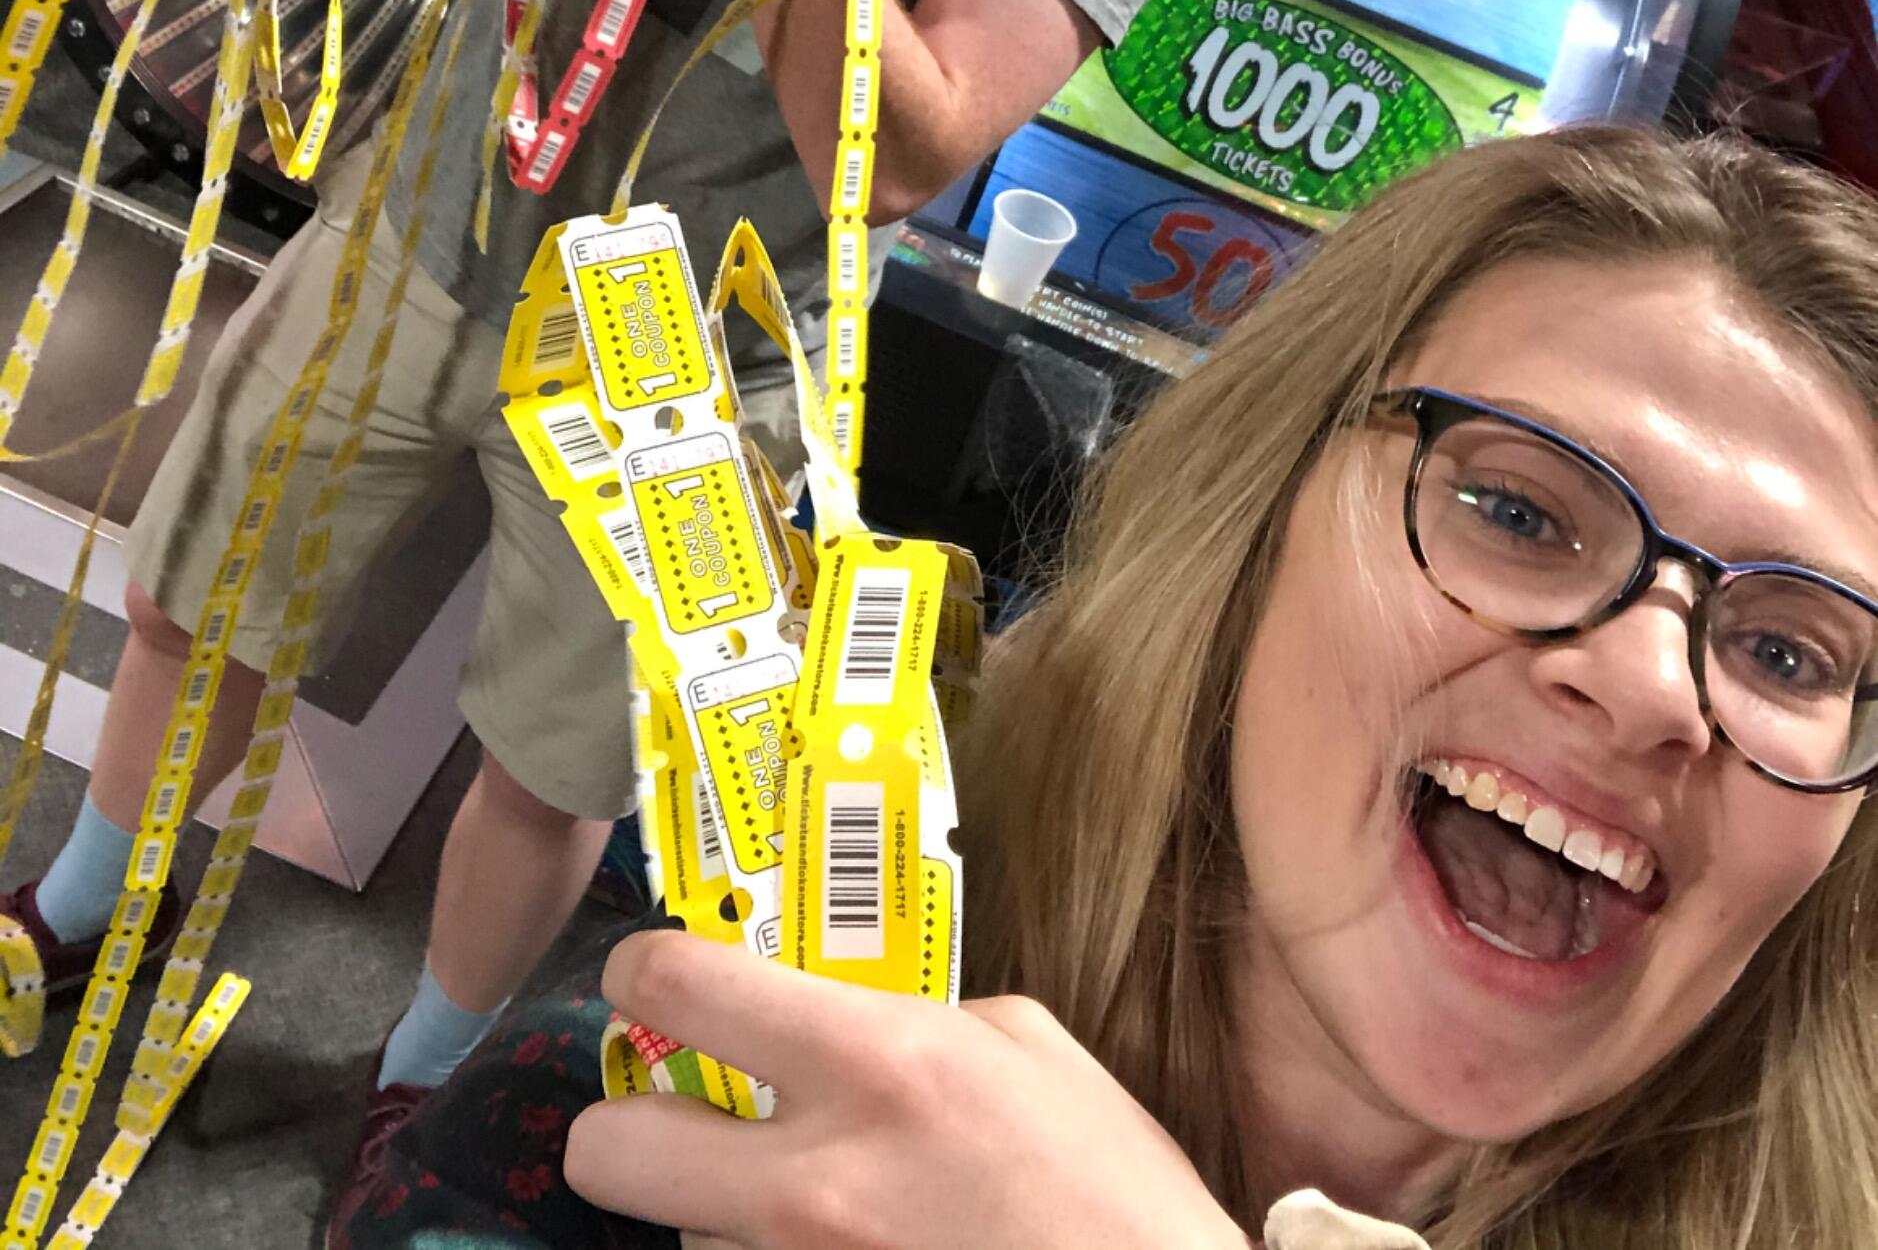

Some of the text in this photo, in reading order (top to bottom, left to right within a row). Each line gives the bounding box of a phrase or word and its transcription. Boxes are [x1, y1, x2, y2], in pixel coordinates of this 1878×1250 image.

[1262, 6, 1337, 56] BASS
[1336, 40, 1404, 95] BONUS
[1186, 25, 1381, 171] 1000
[1211, 141, 1295, 193] TICKETS
[606, 260, 648, 285] 1
[1129, 211, 1274, 329] 50
[620, 301, 649, 359] ONE
[632, 279, 671, 368] COUPON
[635, 371, 678, 397] 1
[662, 473, 706, 500] 1
[677, 517, 708, 578] ONE
[689, 493, 731, 588] COUPON
[695, 590, 740, 620] 1
[907, 590, 929, 673] 1-800-224-1717
[727, 697, 771, 727] 1
[744, 746, 777, 812] ONE
[895, 809, 906, 920] 1-800-224-1717
